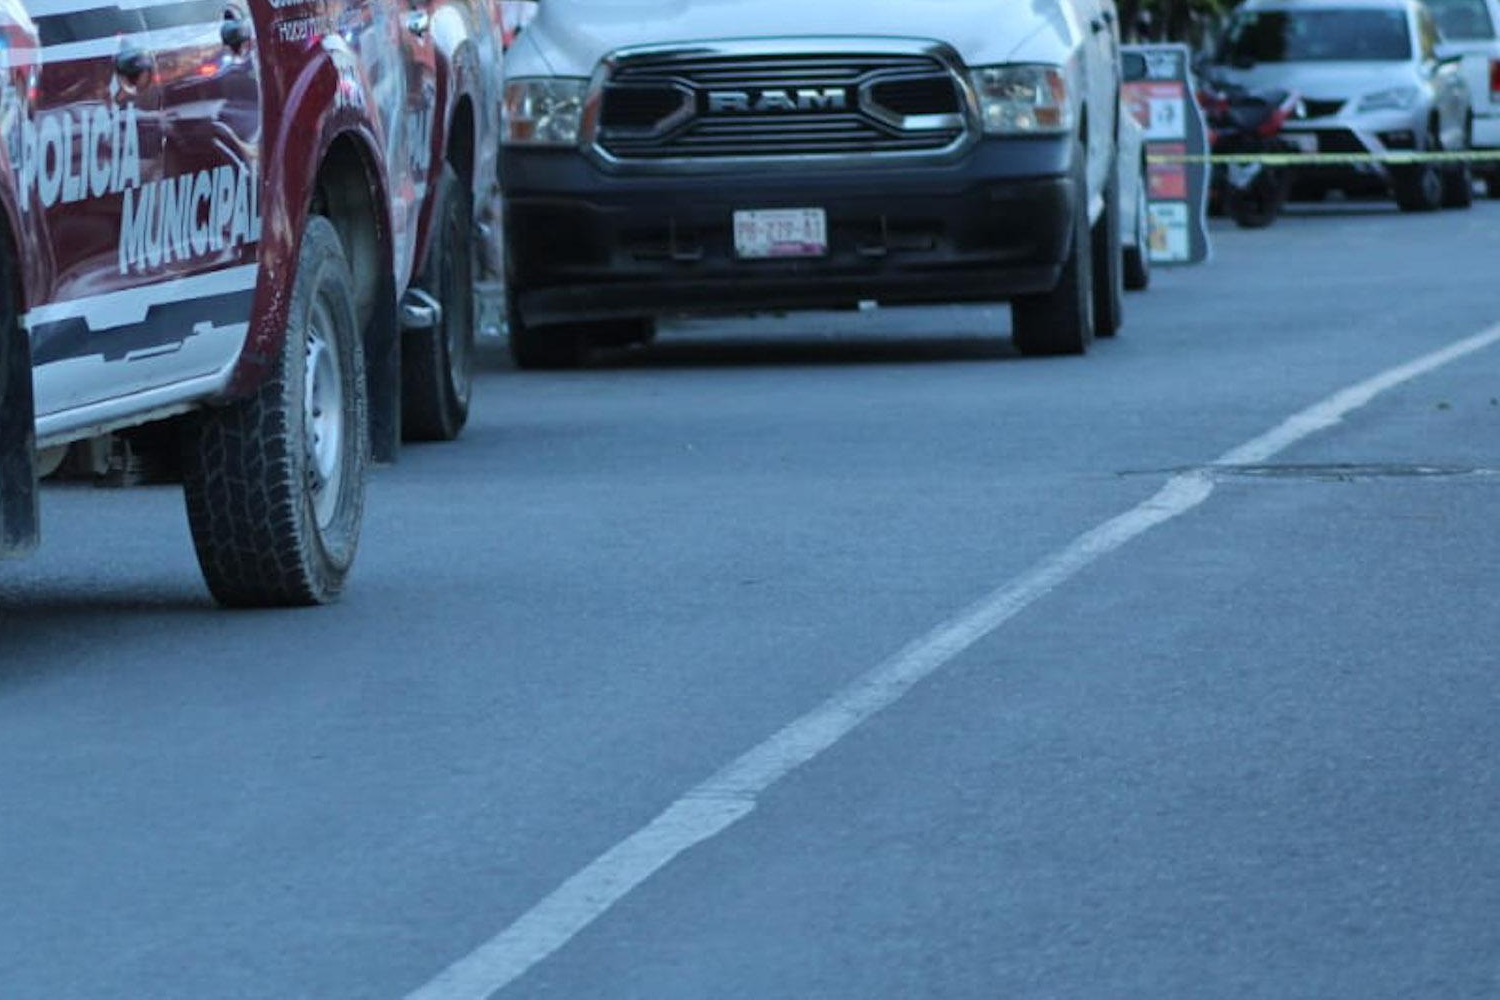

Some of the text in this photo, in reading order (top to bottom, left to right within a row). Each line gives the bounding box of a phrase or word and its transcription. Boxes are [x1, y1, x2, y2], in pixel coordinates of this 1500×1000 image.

[19, 79, 141, 212] POLICÍA
[708, 88, 846, 112] RAM
[119, 163, 263, 275] MUNICIPAL
